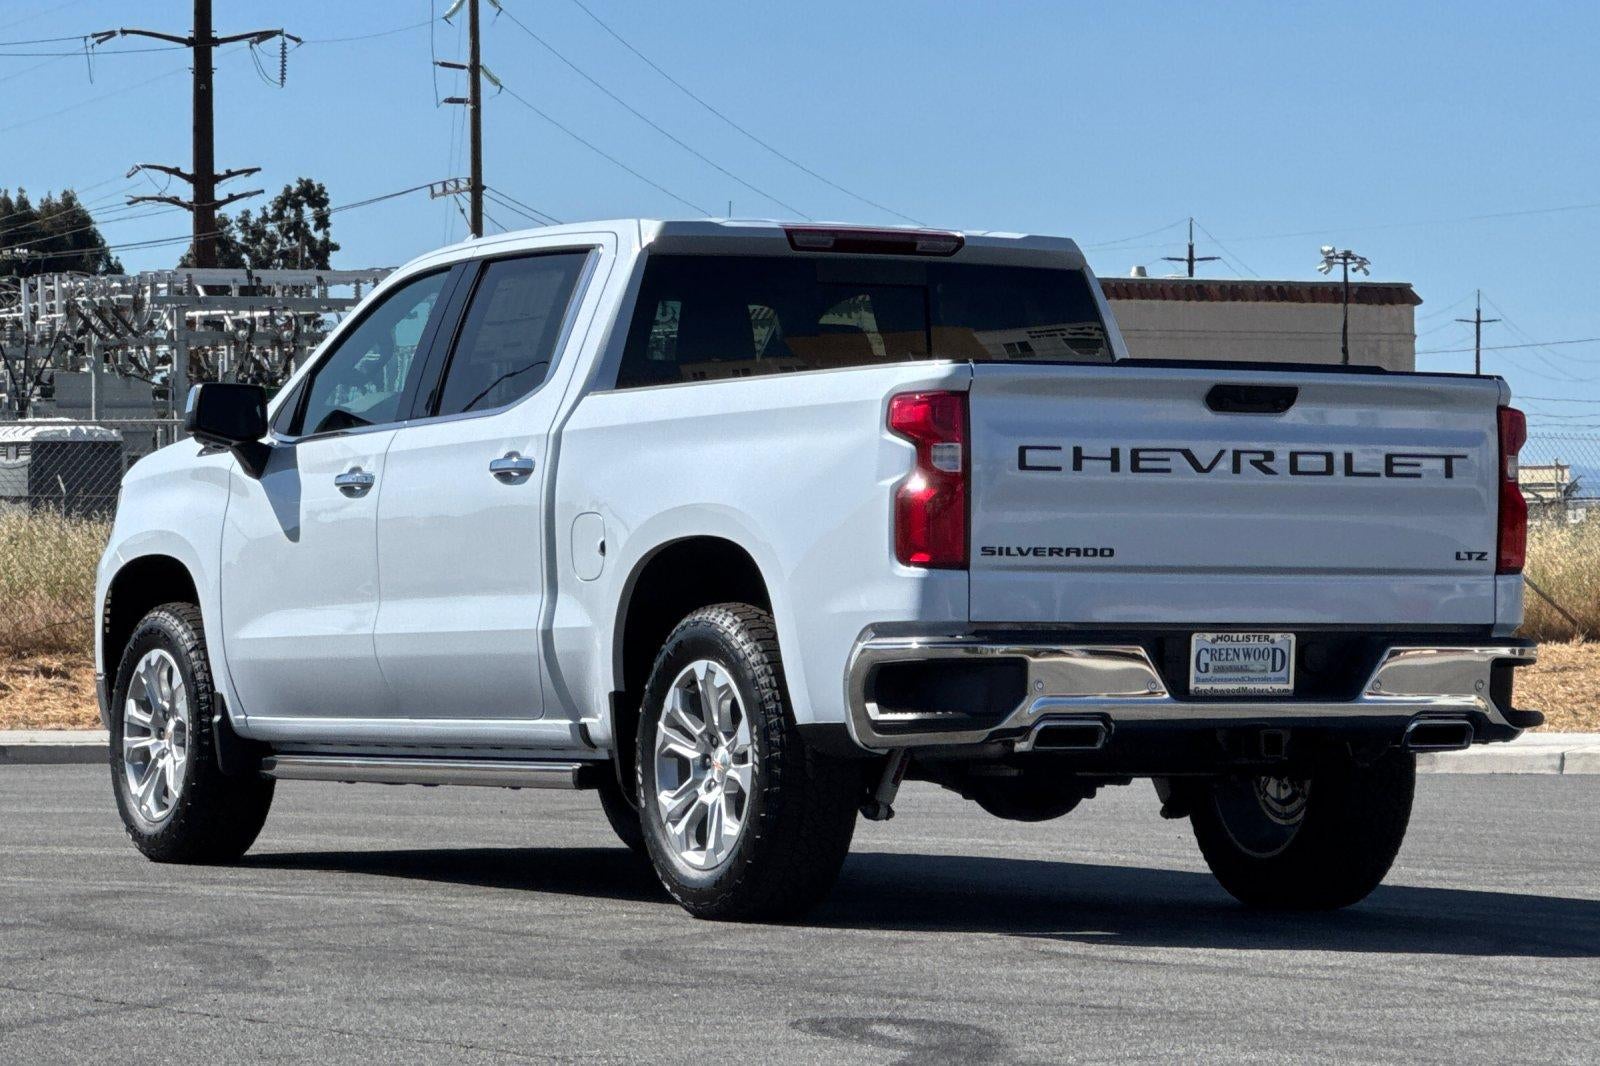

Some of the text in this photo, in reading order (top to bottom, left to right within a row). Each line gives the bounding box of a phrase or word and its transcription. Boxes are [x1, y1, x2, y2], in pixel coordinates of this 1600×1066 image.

[1018, 445, 1468, 479] CHEVROLET
[981, 546, 1115, 558] SILVERADO
[1455, 551, 1489, 562] LTZ
[1215, 634, 1270, 643] HOLLISTER
[1196, 647, 1286, 673] GREENWOOD
